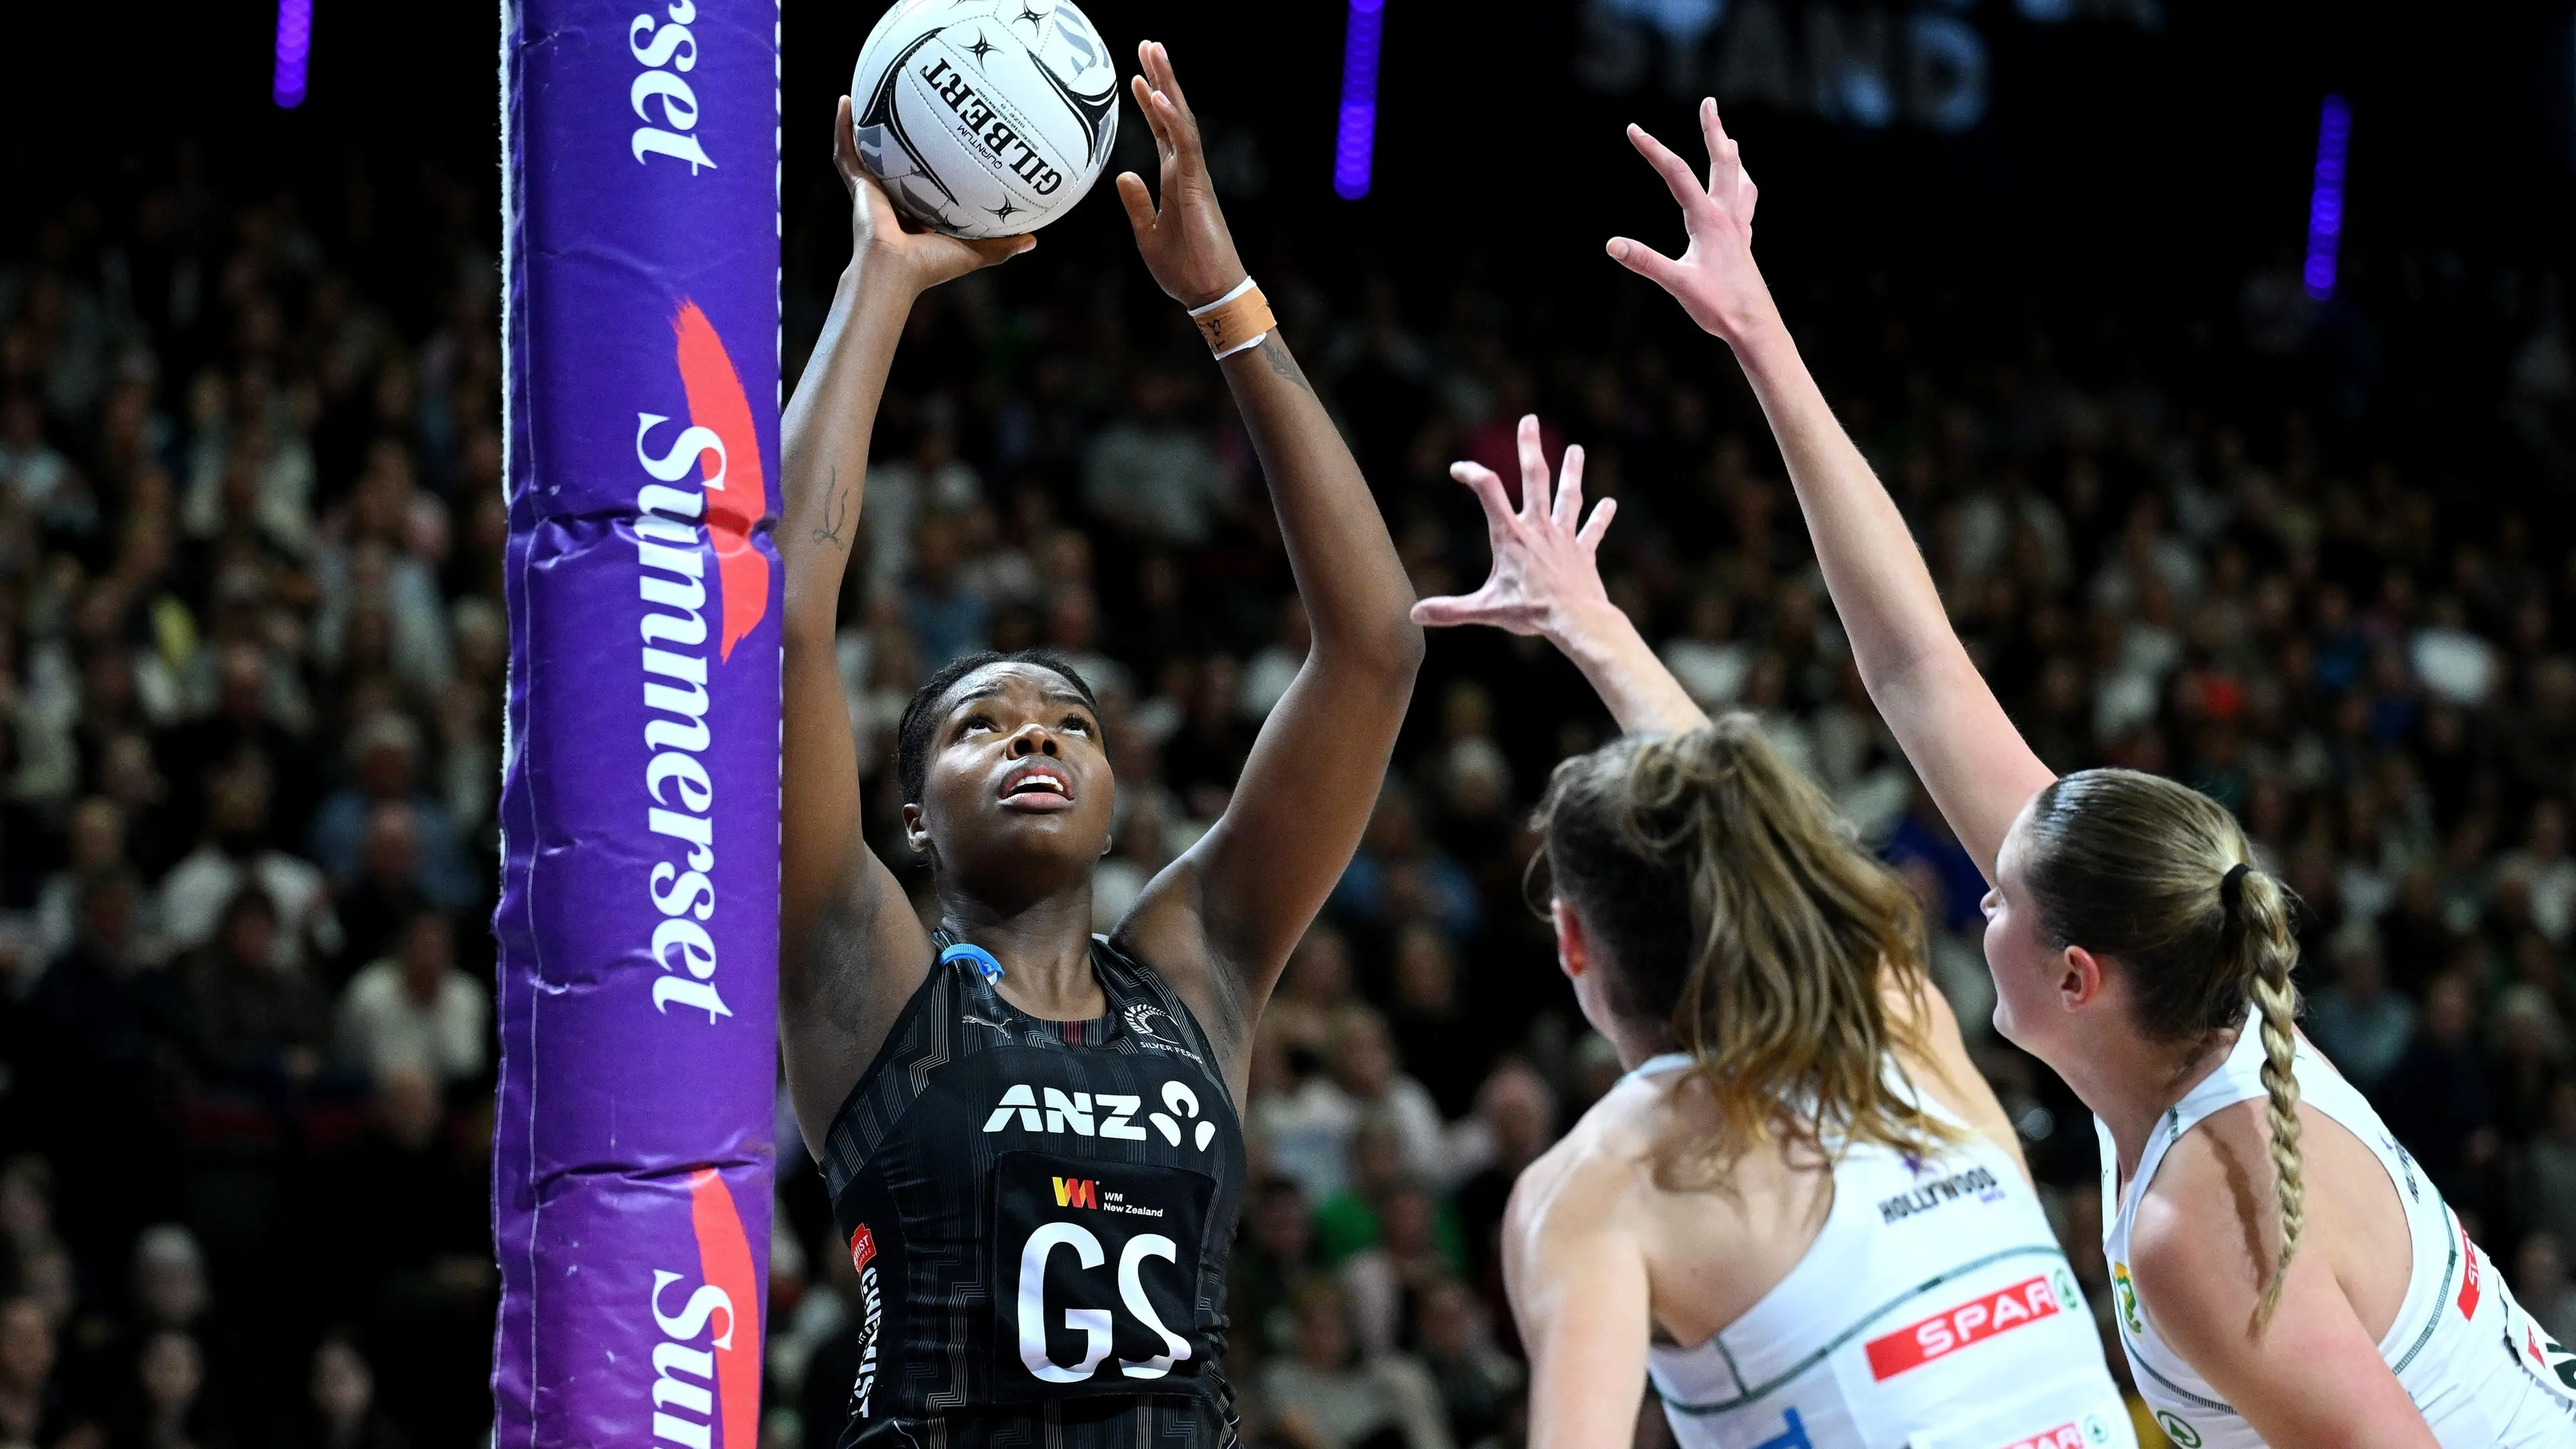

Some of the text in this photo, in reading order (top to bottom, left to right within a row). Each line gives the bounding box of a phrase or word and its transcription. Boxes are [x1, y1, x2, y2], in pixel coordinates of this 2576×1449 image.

[920, 58, 1062, 195] GILBERT
[957, 125, 1003, 169] QUANTUM
[633, 412, 733, 1025] Summerset
[1140, 1041, 1203, 1064] SILVER FERNS
[983, 1084, 1146, 1140] ANZ
[1104, 1192, 1123, 1202] WM
[1104, 1203, 1163, 1218] New Zealand
[1878, 1165, 1997, 1225] HOLLYWOOD
[1018, 1222, 1192, 1383] GS
[1916, 1281, 2057, 1358] SPAR
